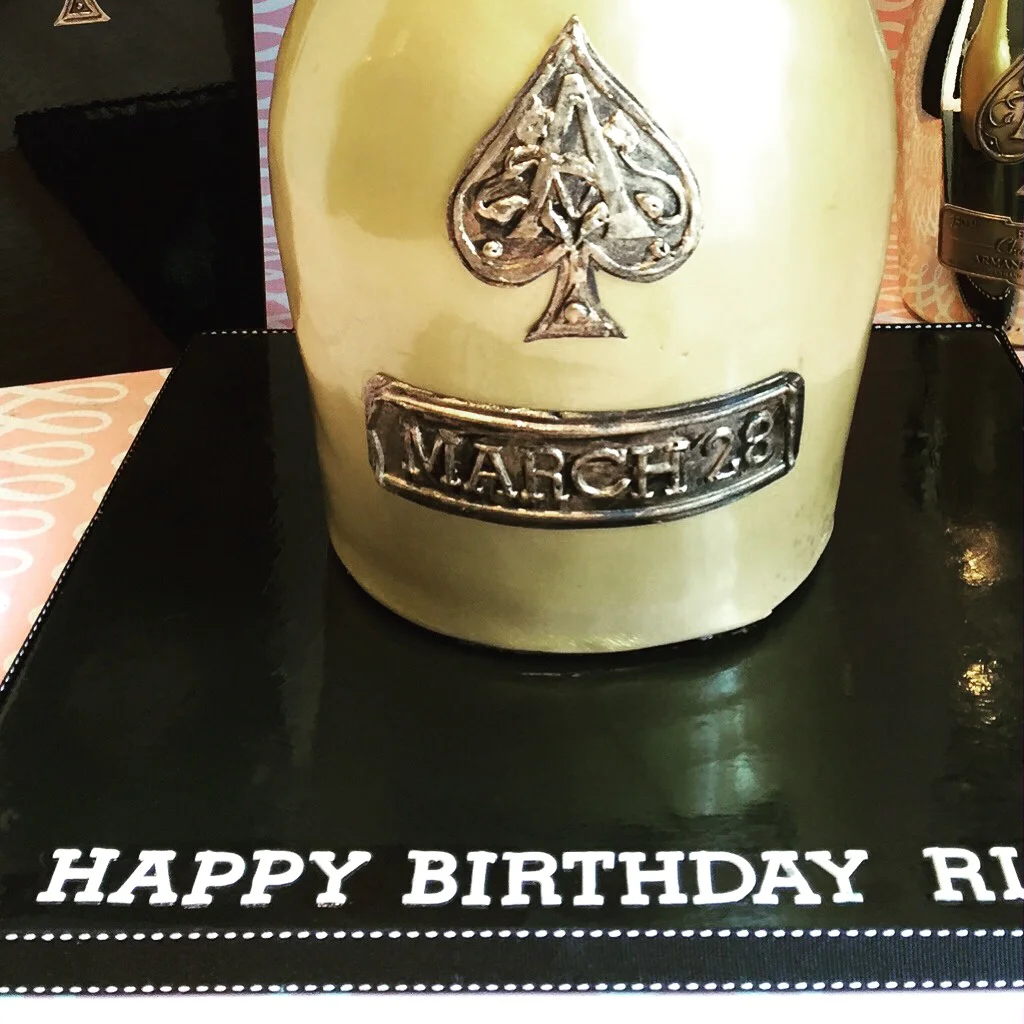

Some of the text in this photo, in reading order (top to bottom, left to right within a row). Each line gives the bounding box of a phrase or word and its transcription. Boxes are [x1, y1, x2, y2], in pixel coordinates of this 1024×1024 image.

[402, 409, 775, 500] MARCH 28
[36, 847, 372, 908] HAPPY
[401, 848, 869, 906] BIRTHDAY
